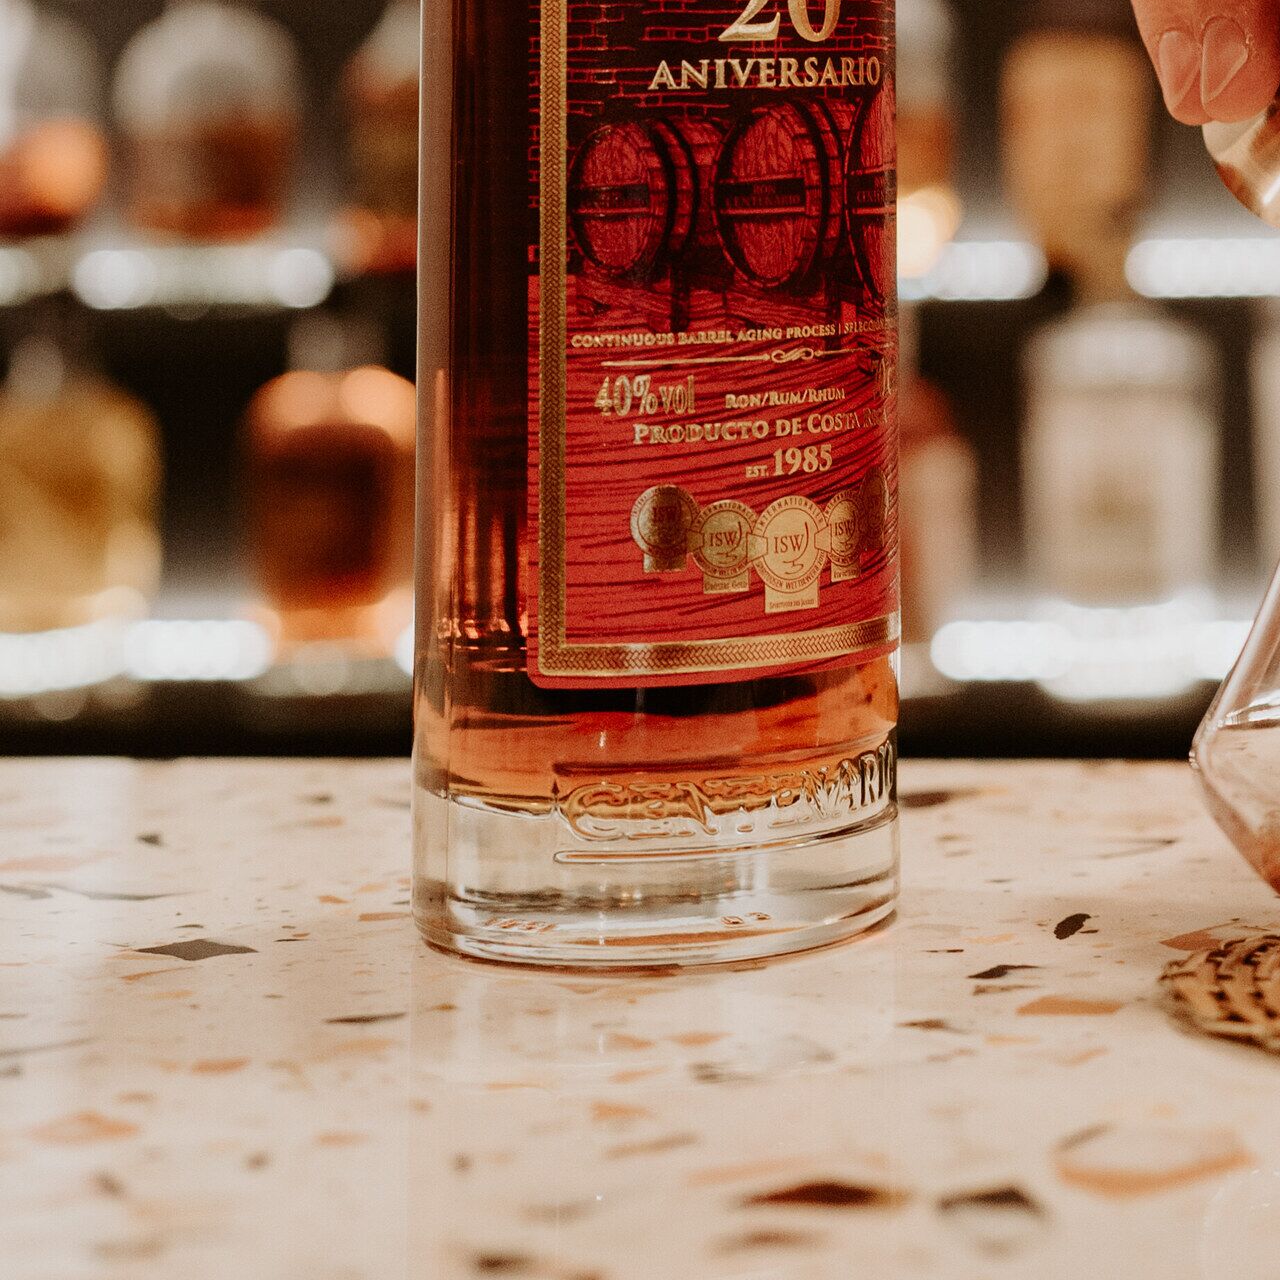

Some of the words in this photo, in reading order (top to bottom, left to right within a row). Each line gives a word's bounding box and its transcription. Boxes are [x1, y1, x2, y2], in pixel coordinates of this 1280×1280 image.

[648, 56, 881, 91] ANIVERSARIO
[571, 332, 674, 348] CONTINUOUS
[677, 330, 734, 345] BARREL
[737, 327, 783, 341] AGING
[786, 323, 836, 339] PROCESS
[633, 420, 770, 445] PRODUCTO
[775, 417, 803, 437] DE
[807, 411, 861, 433] COSTA
[746, 464, 770, 479] EST.
[773, 443, 833, 477] 1985
[710, 530, 738, 547] ISW
[774, 534, 805, 555] ISW
